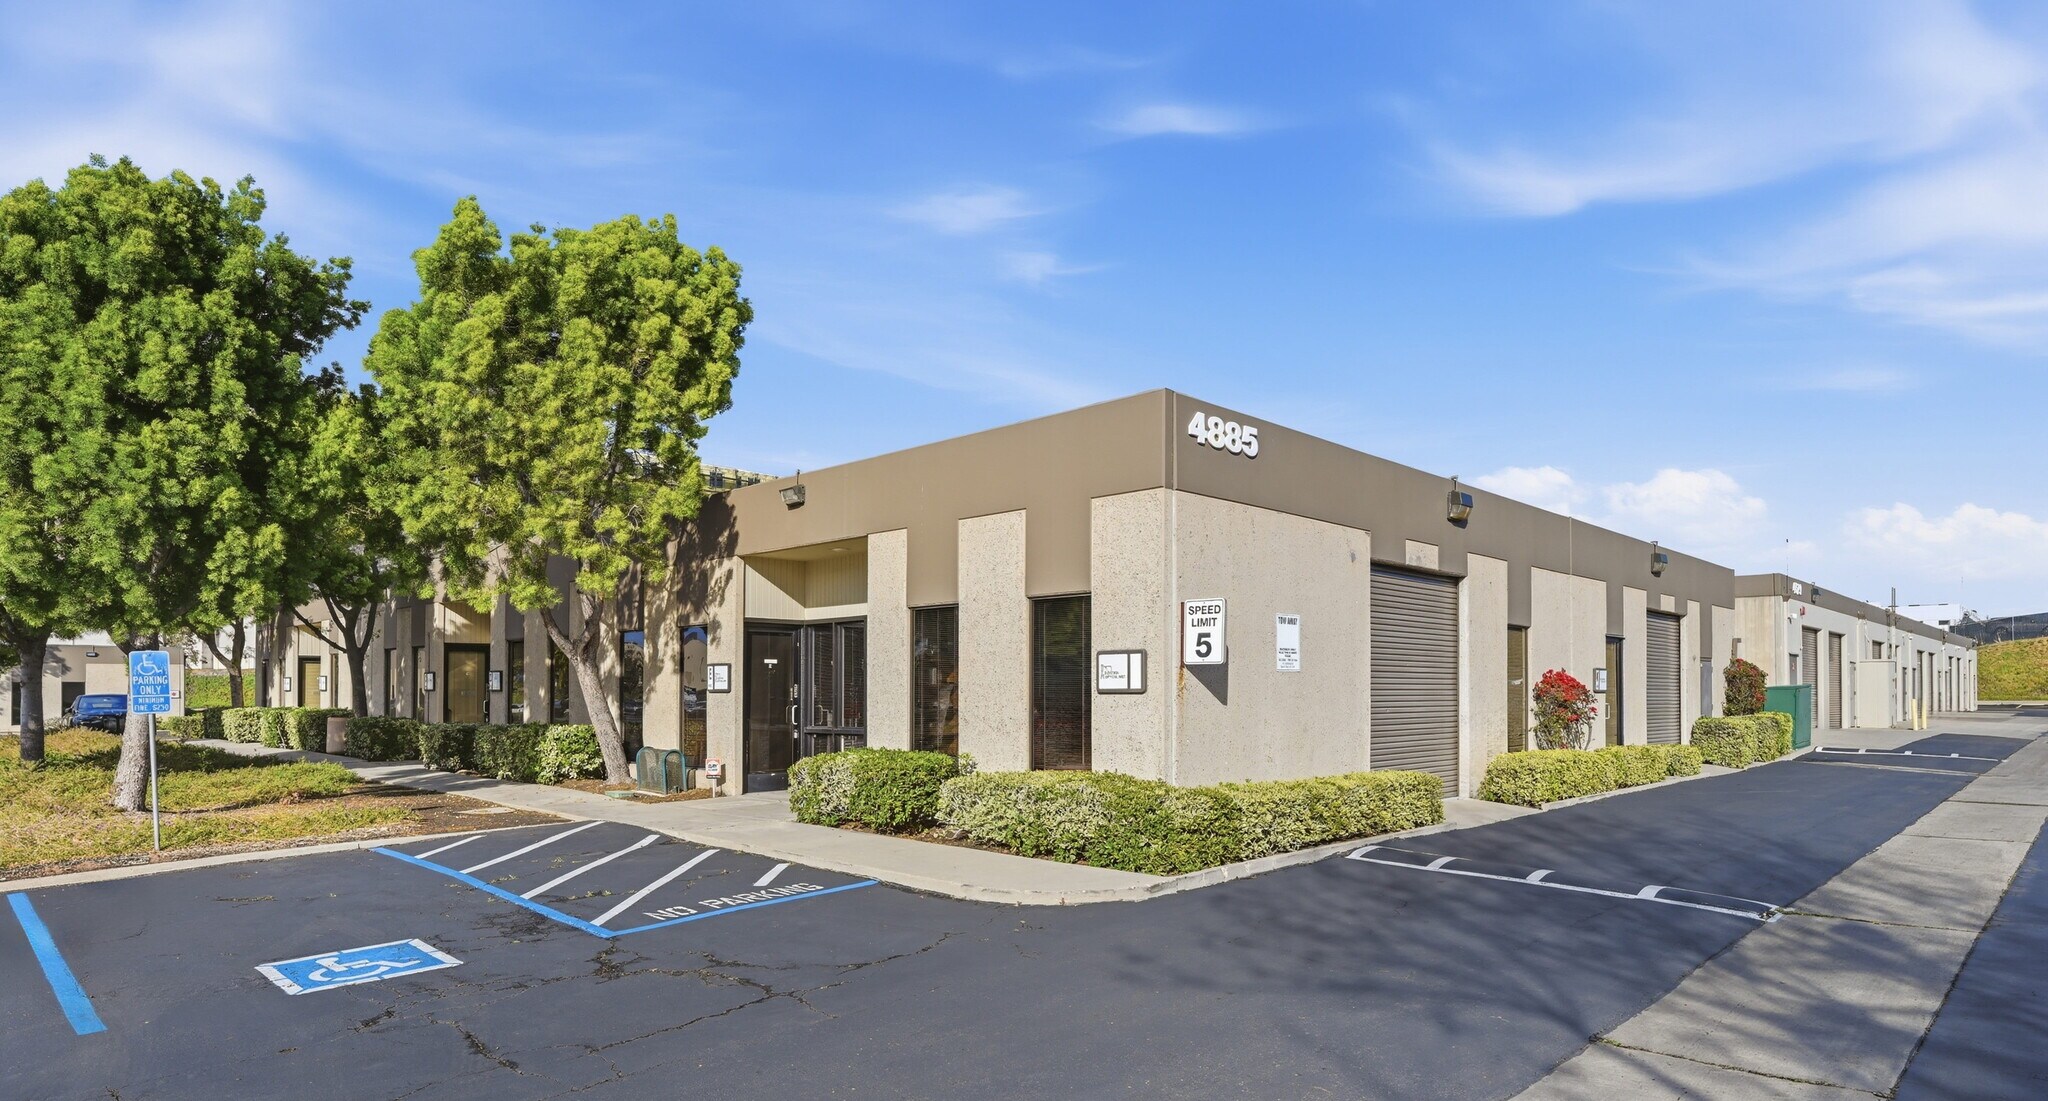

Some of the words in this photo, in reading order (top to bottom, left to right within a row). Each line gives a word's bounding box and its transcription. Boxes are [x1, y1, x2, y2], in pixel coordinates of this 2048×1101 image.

[1188, 411, 1259, 458] 4885
[1188, 604, 1222, 616] SPEED
[1191, 617, 1218, 628] LIMIT
[1195, 632, 1212, 658] 5
[132, 675, 168, 685] PARKING
[140, 685, 162, 695] ONLY
[643, 906, 698, 921] NO
[698, 882, 825, 909] PARKING
